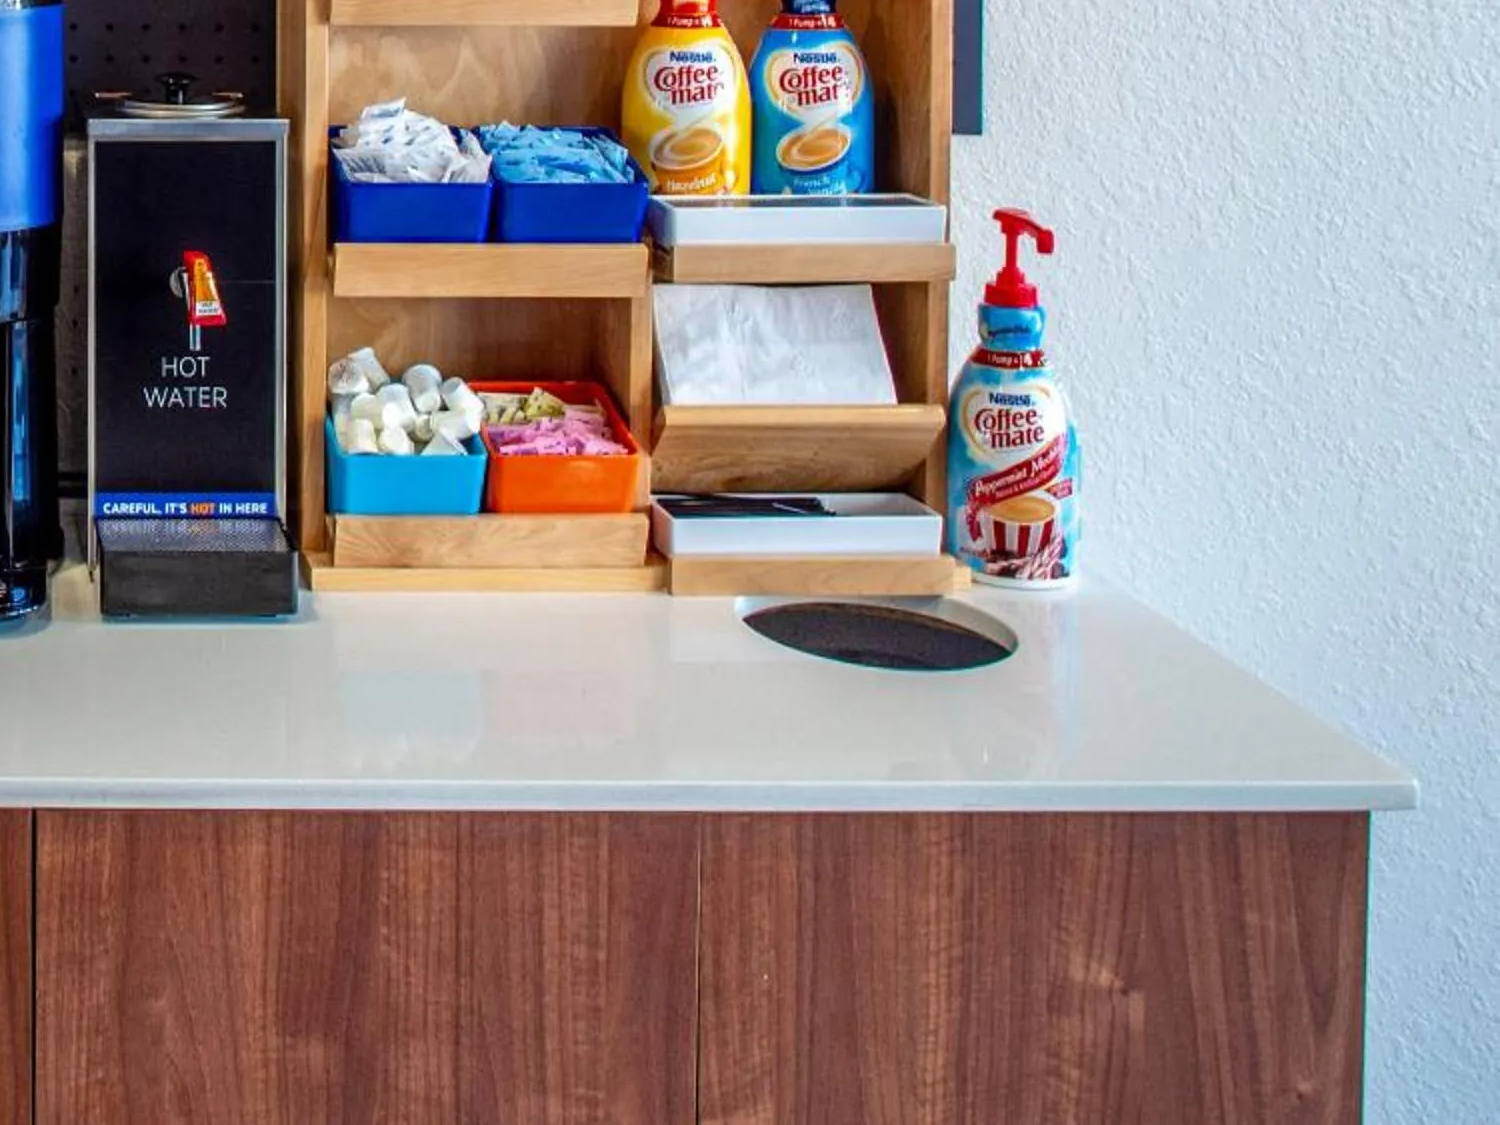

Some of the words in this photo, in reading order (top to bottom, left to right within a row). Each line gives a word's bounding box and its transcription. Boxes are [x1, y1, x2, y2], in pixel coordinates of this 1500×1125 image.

[653, 64, 719, 92] Coffee
[779, 65, 843, 94] Coffee
[797, 83, 849, 107] mat
[161, 355, 211, 379] HOT
[143, 386, 228, 409] WATER
[974, 408, 1038, 435] Coffee
[990, 425, 1045, 450] mate
[191, 501, 217, 516] HOT
[219, 501, 232, 516] IN
[235, 501, 268, 516] HERE
